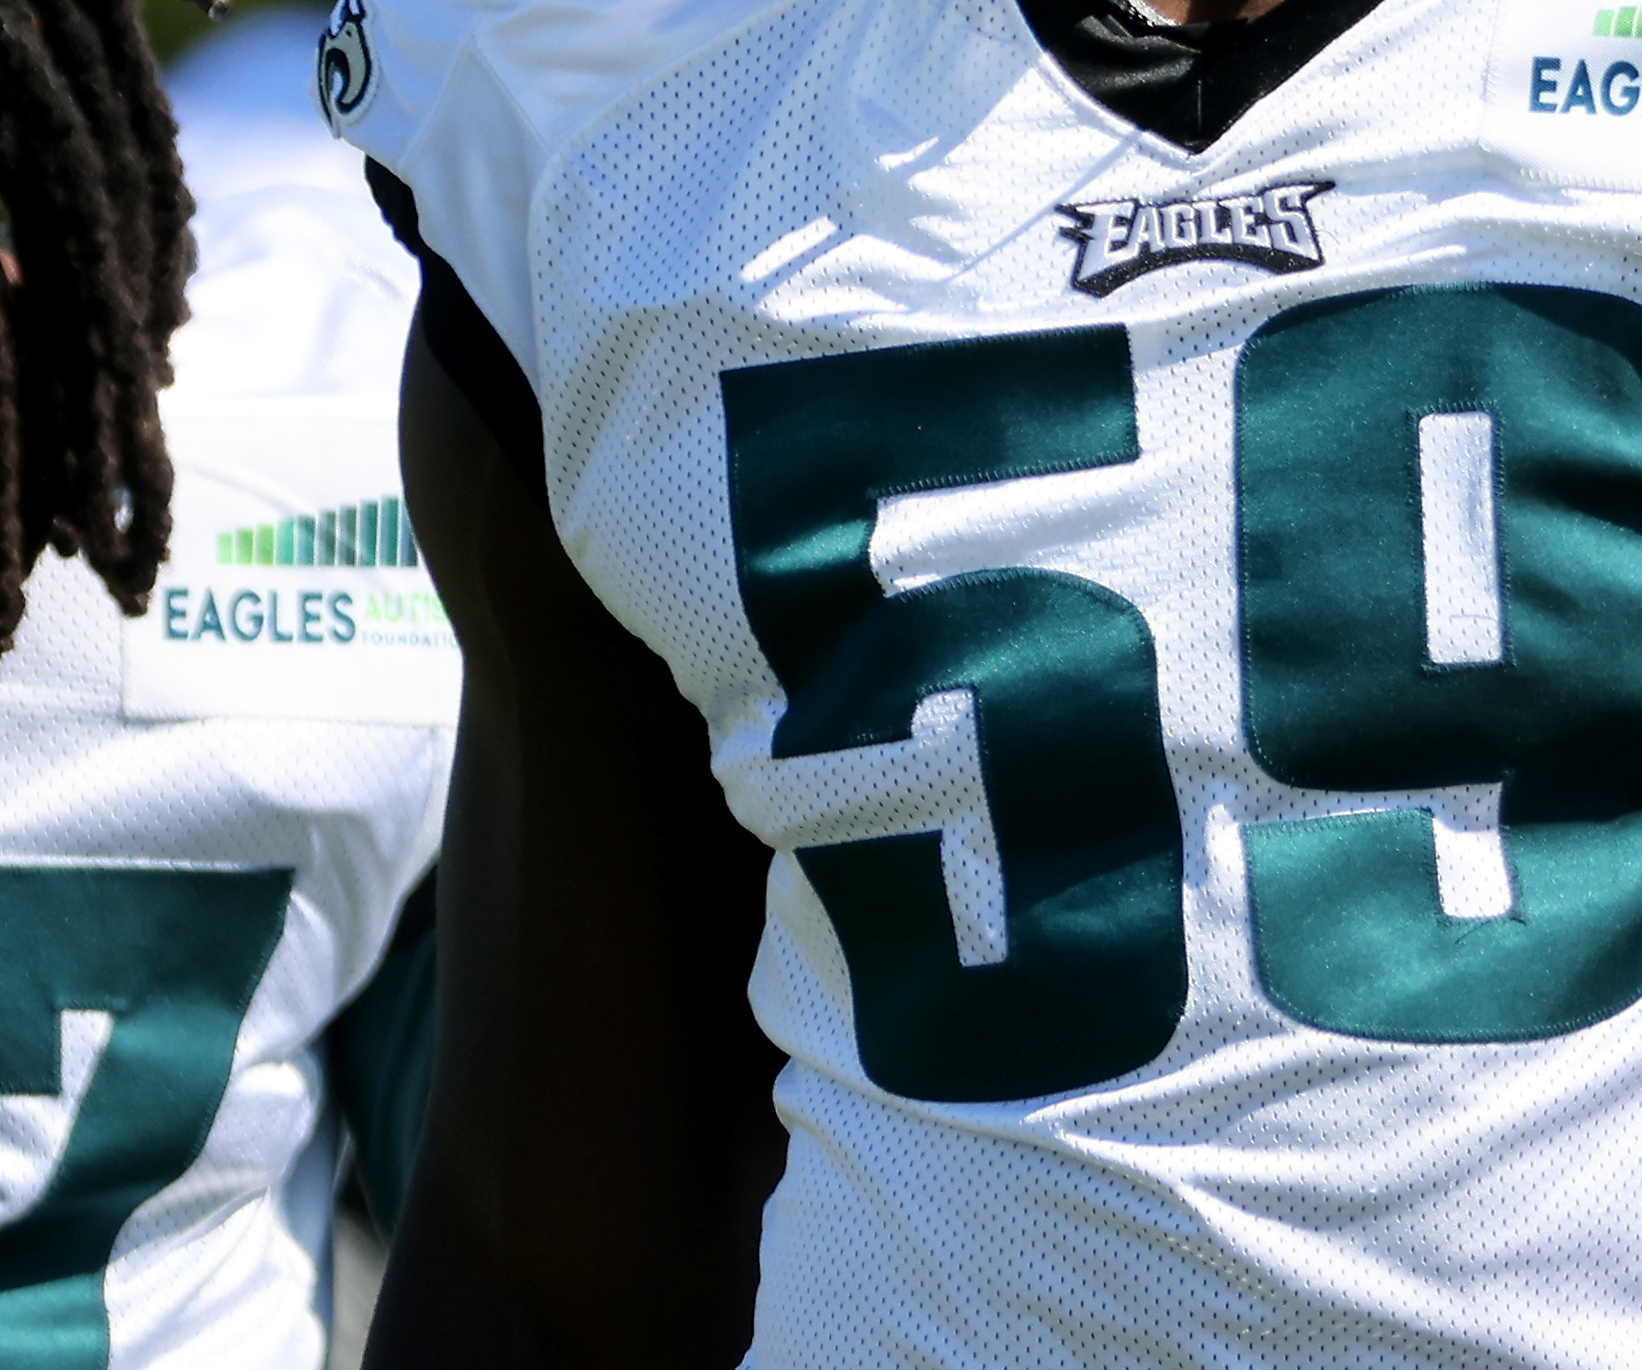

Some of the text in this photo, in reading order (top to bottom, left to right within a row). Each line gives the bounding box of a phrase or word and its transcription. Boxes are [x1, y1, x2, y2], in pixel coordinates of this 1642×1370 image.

[1061, 182, 1331, 293] EAGLES
[162, 586, 450, 644] EAGLES AUTIS
[361, 631, 459, 648] FOUNDATIO
